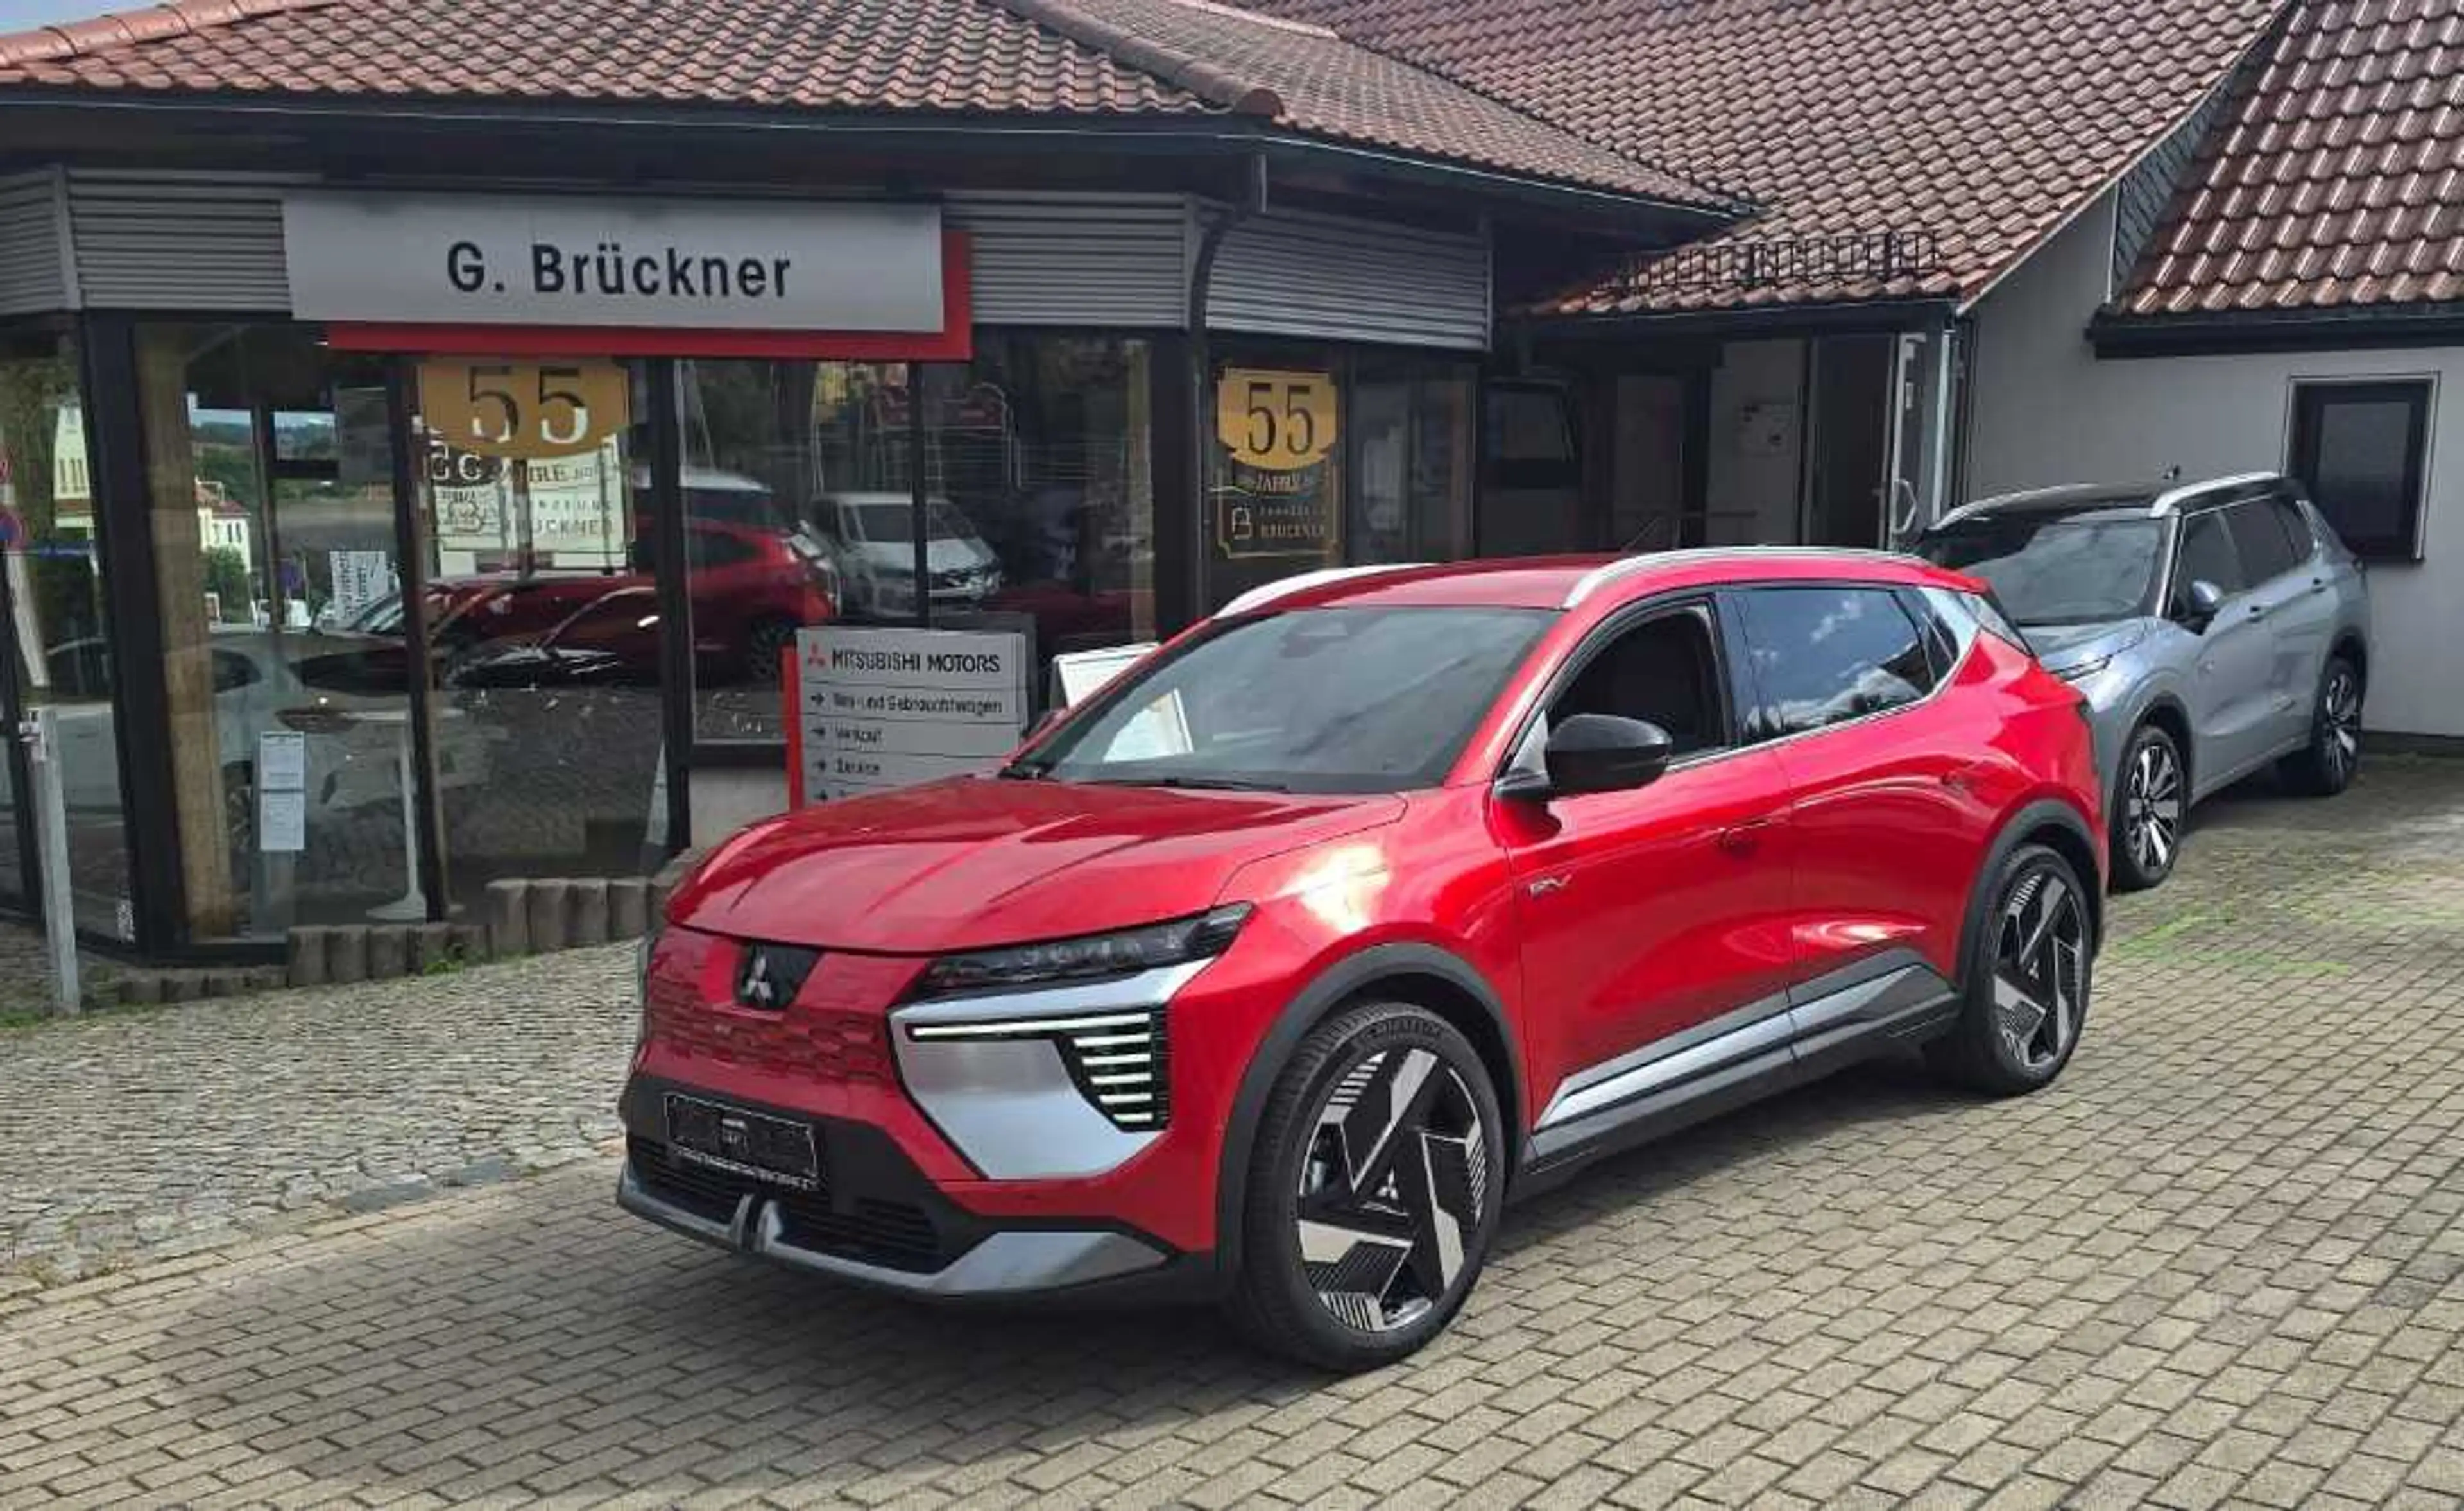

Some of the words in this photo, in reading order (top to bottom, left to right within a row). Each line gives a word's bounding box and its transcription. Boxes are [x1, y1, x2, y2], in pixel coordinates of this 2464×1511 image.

[448, 241, 506, 293] G.
[531, 243, 791, 298] Brückner
[468, 366, 589, 444] 55
[1248, 382, 1313, 456] 55
[832, 648, 921, 672] MITSUBISHI
[927, 653, 1002, 674] MOTORS
